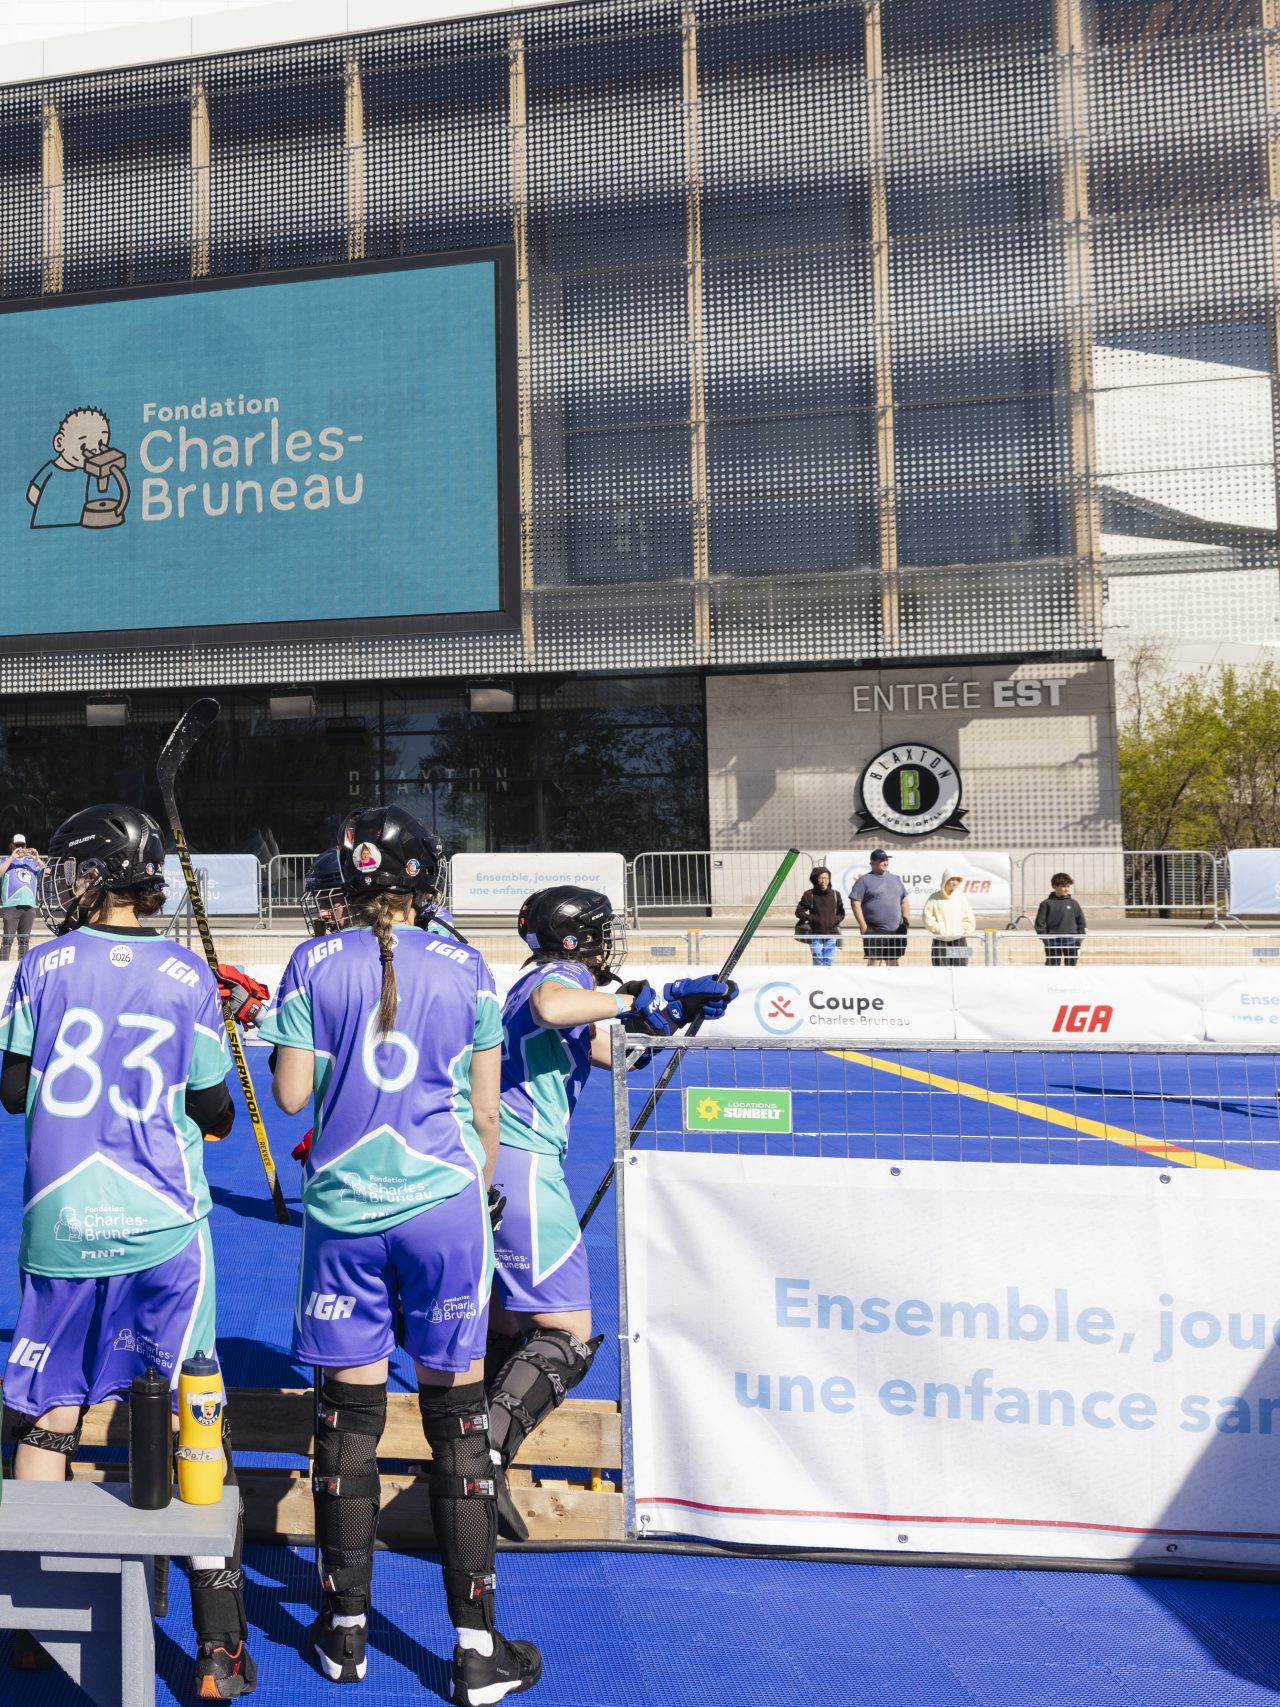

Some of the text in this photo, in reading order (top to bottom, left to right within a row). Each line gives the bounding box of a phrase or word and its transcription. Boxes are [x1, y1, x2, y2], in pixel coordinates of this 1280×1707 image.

[143, 394, 279, 423] Fondation
[140, 417, 363, 473] Charles-
[141, 473, 363, 521] Bruneau
[853, 676, 1067, 713] ENTRÉE EST
[870, 748, 952, 780] BLAXTON
[900, 770, 921, 811] B
[881, 813, 900, 825] PUB
[915, 809, 946, 827] GRILL
[68, 834, 96, 848] BAUER
[476, 873, 600, 883] Ensemble, jouons pour
[497, 886, 535, 895] enfance
[902, 875, 932, 886] upe
[963, 880, 991, 893] IGA
[39, 946, 76, 977] IGA
[111, 953, 131, 962] 2026
[308, 938, 343, 967] IGA
[425, 940, 470, 965] IGA
[157, 957, 200, 988] IGA
[809, 990, 884, 1015] Coupe
[809, 1015, 910, 1026] Charles-Bruneau
[1052, 1005, 1113, 1032] IGA
[362, 996, 419, 1092] 6
[42, 1007, 176, 1123] 83
[228, 1032, 259, 1124] SHERWOOD
[723, 1107, 781, 1120] SUNBELT
[259, 1141, 272, 1168] REKKER
[369, 1175, 407, 1183] Fondation
[369, 1182, 429, 1196] Charles-
[83, 1214, 148, 1228] Charles-
[85, 1226, 149, 1242] Bruneau
[81, 1248, 125, 1259] MNM
[494, 1253, 528, 1262] Charles-
[494, 1261, 530, 1269] Bruneau
[305, 1291, 356, 1320] IGA
[774, 1277, 1136, 1354] Ensemble,
[137, 1345, 173, 1369] Bruneau
[734, 1371, 858, 1415] une
[877, 1367, 1158, 1431] enfance
